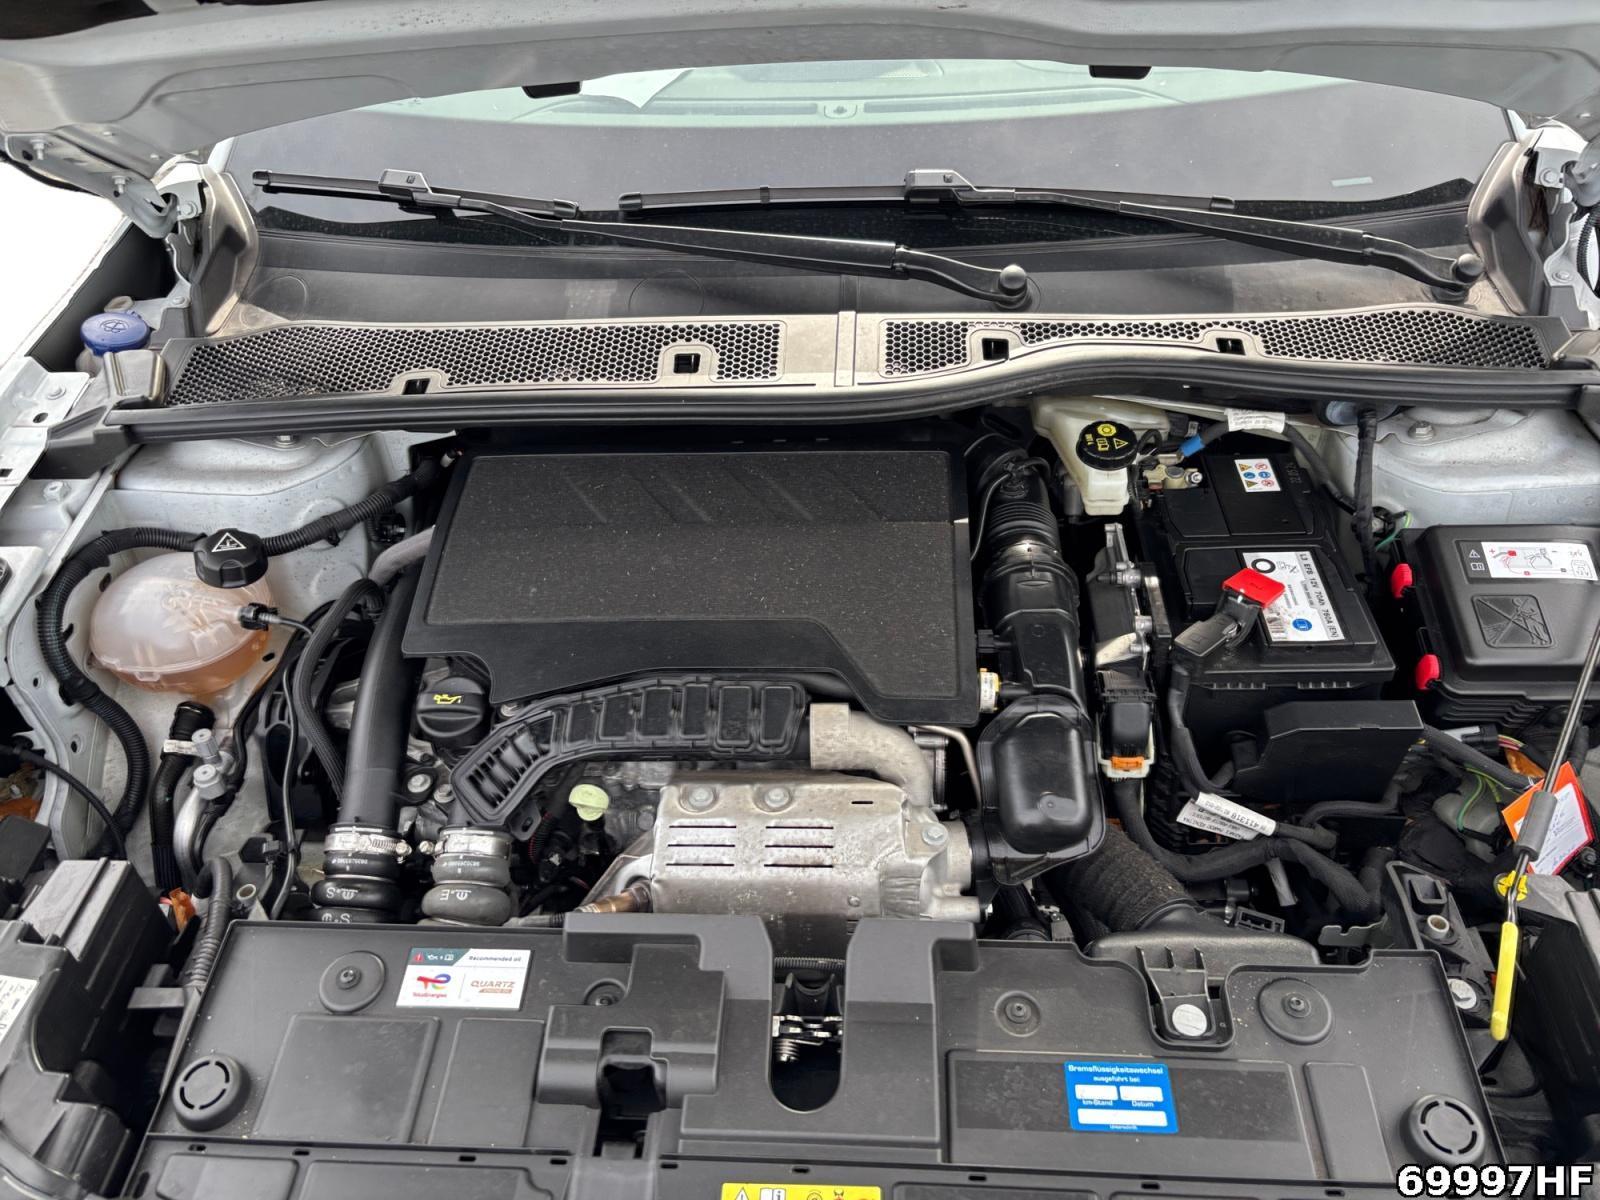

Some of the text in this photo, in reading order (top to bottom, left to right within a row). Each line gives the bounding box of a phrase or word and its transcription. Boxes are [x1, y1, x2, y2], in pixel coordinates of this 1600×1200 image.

[1303, 563, 1314, 575] EFB
[470, 980, 516, 988] QUARTZ
[1068, 1064, 1164, 1075] Bremsflüssigkeitswechsel
